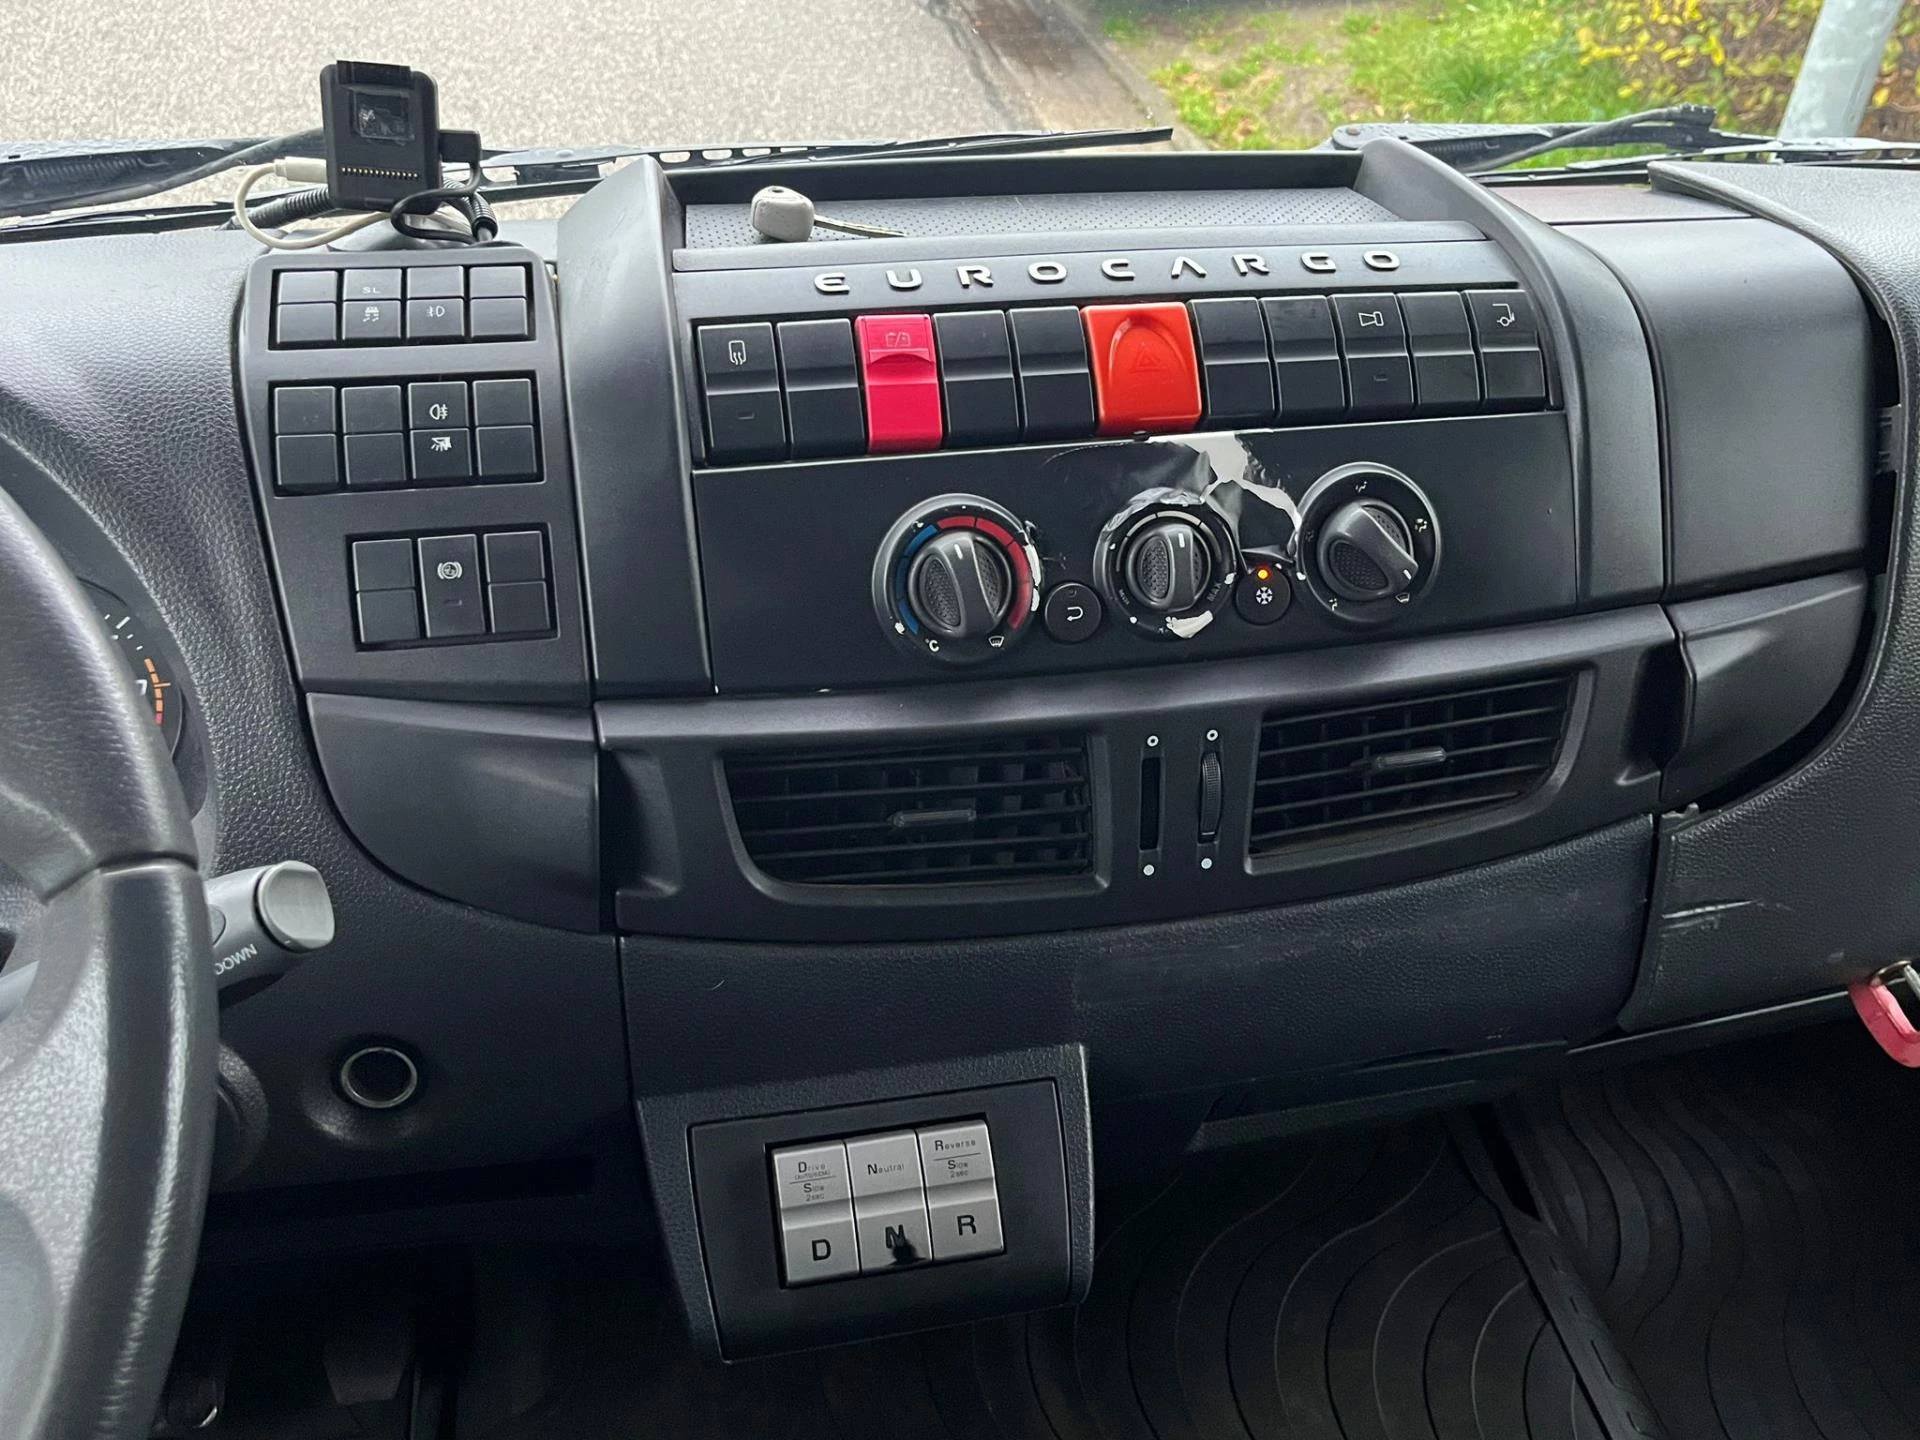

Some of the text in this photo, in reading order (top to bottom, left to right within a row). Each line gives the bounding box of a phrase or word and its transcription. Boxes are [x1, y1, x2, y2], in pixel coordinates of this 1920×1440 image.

[813, 250, 1401, 293] EUROCARGO
[934, 1139, 976, 1151] Reverse
[867, 1162, 905, 1175] Neutral
[957, 1214, 977, 1236] R
[811, 1238, 832, 1262] D
